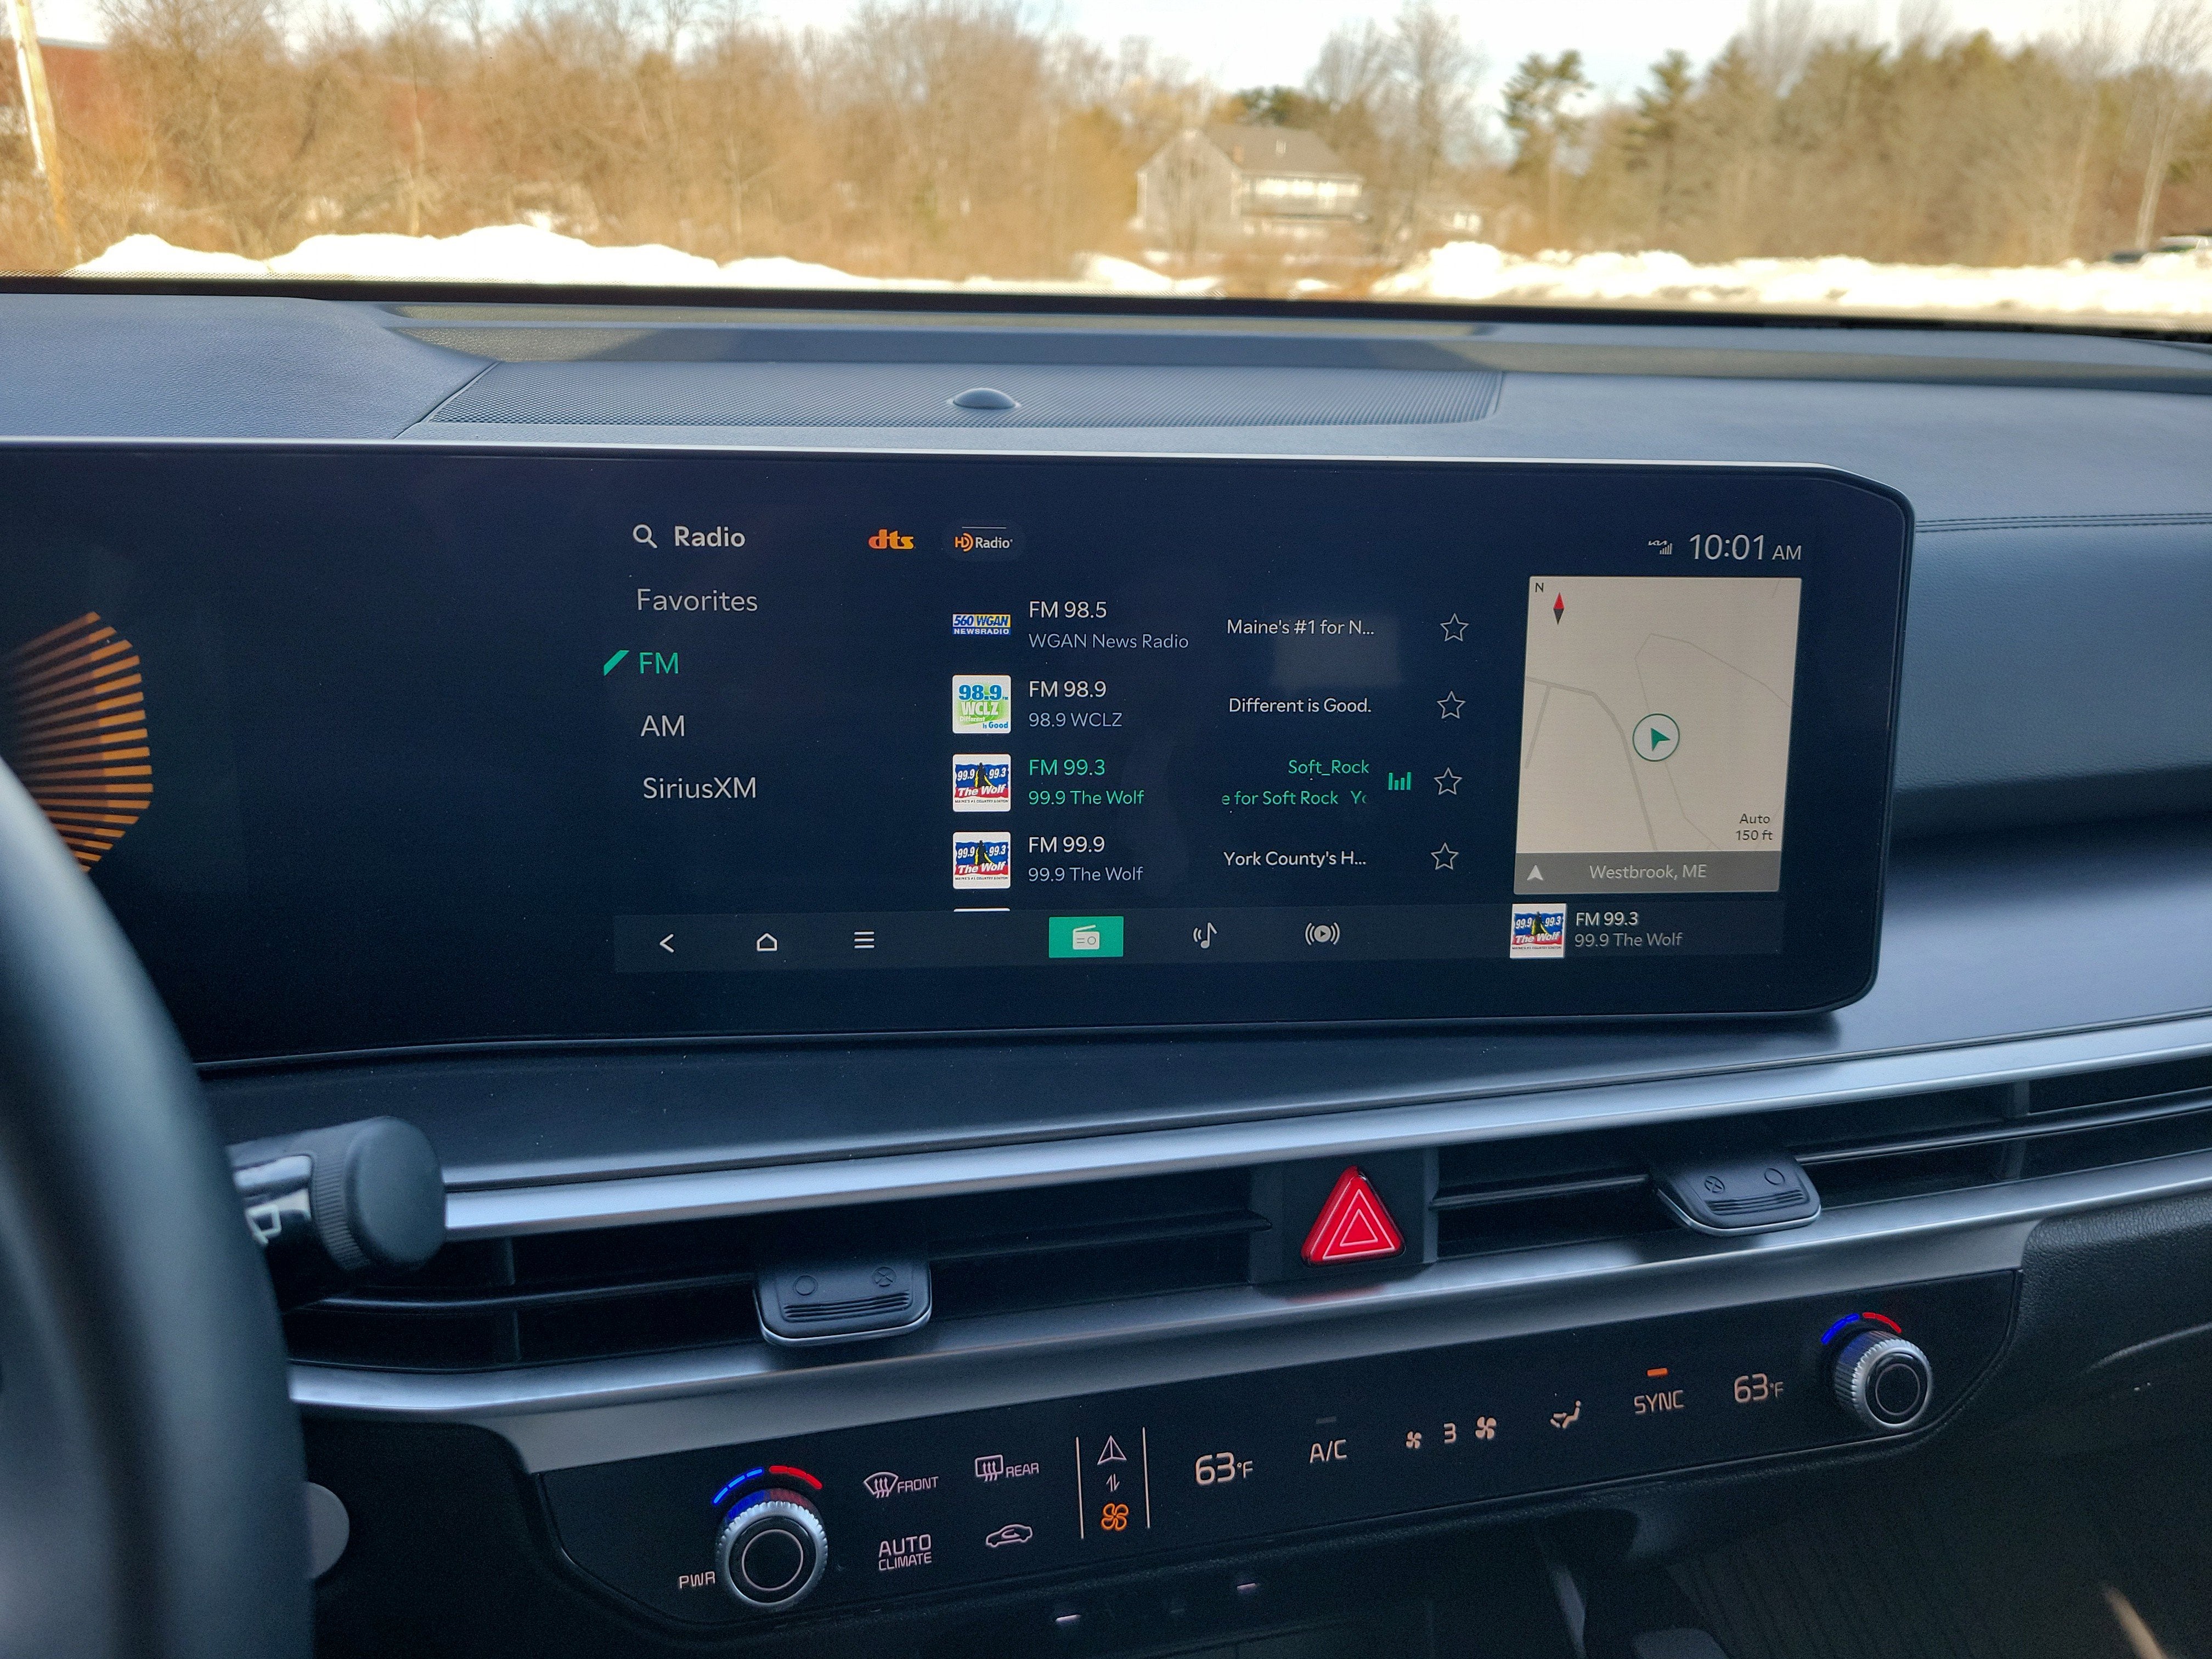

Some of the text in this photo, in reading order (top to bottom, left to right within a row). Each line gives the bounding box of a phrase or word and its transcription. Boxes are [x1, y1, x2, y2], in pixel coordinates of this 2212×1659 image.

[674, 525, 746, 548] Radio
[868, 529, 914, 549] dts
[1690, 534, 1802, 561] 10:01 AM
[1534, 582, 1544, 593] N
[636, 589, 758, 612] Favorites
[1029, 601, 1107, 619] FM 98.5
[953, 615, 1009, 627] 560 WGAN
[1227, 619, 1289, 635] Maine's
[1294, 620, 1316, 635] #1
[1320, 619, 1345, 634] for
[1029, 634, 1189, 648] WGAN News Radio
[639, 652, 679, 675] FM
[959, 684, 1002, 701] 98.9
[1029, 681, 1107, 698] FM 98.9
[961, 702, 998, 715] WCLZ
[1229, 697, 1372, 713] Different is Good.
[640, 716, 685, 737] AM
[1029, 712, 1122, 727] 98.9 WCLZ
[957, 767, 1007, 781] 99.9 99.3
[1029, 759, 1106, 776] FM 99.3
[1288, 759, 1369, 776] Soft_Rock
[643, 776, 757, 799] SiriusXM
[958, 784, 1007, 797] The Wolf
[1029, 789, 1145, 805] 99.9 The Wolf
[1234, 791, 1259, 805] for
[1262, 790, 1296, 805] Soft
[1301, 790, 1339, 805] Rock
[1739, 813, 1770, 825] Auto
[1736, 830, 1773, 841] 150 ft
[957, 844, 1007, 859] 99.9 99.3
[1028, 837, 1105, 854] FM 99.9
[958, 861, 1007, 874] The Wolf
[1223, 851, 1261, 866] York
[1265, 851, 1336, 870] County's
[1028, 866, 1143, 882] 99.9 The Wolf
[1589, 865, 1707, 881] Westbrook, ME
[1515, 915, 1561, 929] 99.9 99.3
[1576, 912, 1639, 926] FM 99.3
[1515, 931, 1561, 944] The Wolf
[1575, 932, 1683, 947] 99.9 The Wolf
[1634, 1390, 1685, 1414] SYNC
[1443, 1424, 1455, 1443] 3
[1310, 1438, 1347, 1465] A/C
[1006, 1462, 1040, 1478] REAR
[897, 1476, 939, 1494] FRONT
[878, 1534, 932, 1558] AUTO
[878, 1551, 932, 1572] CLIMATE
[679, 1571, 716, 1589] PWR
